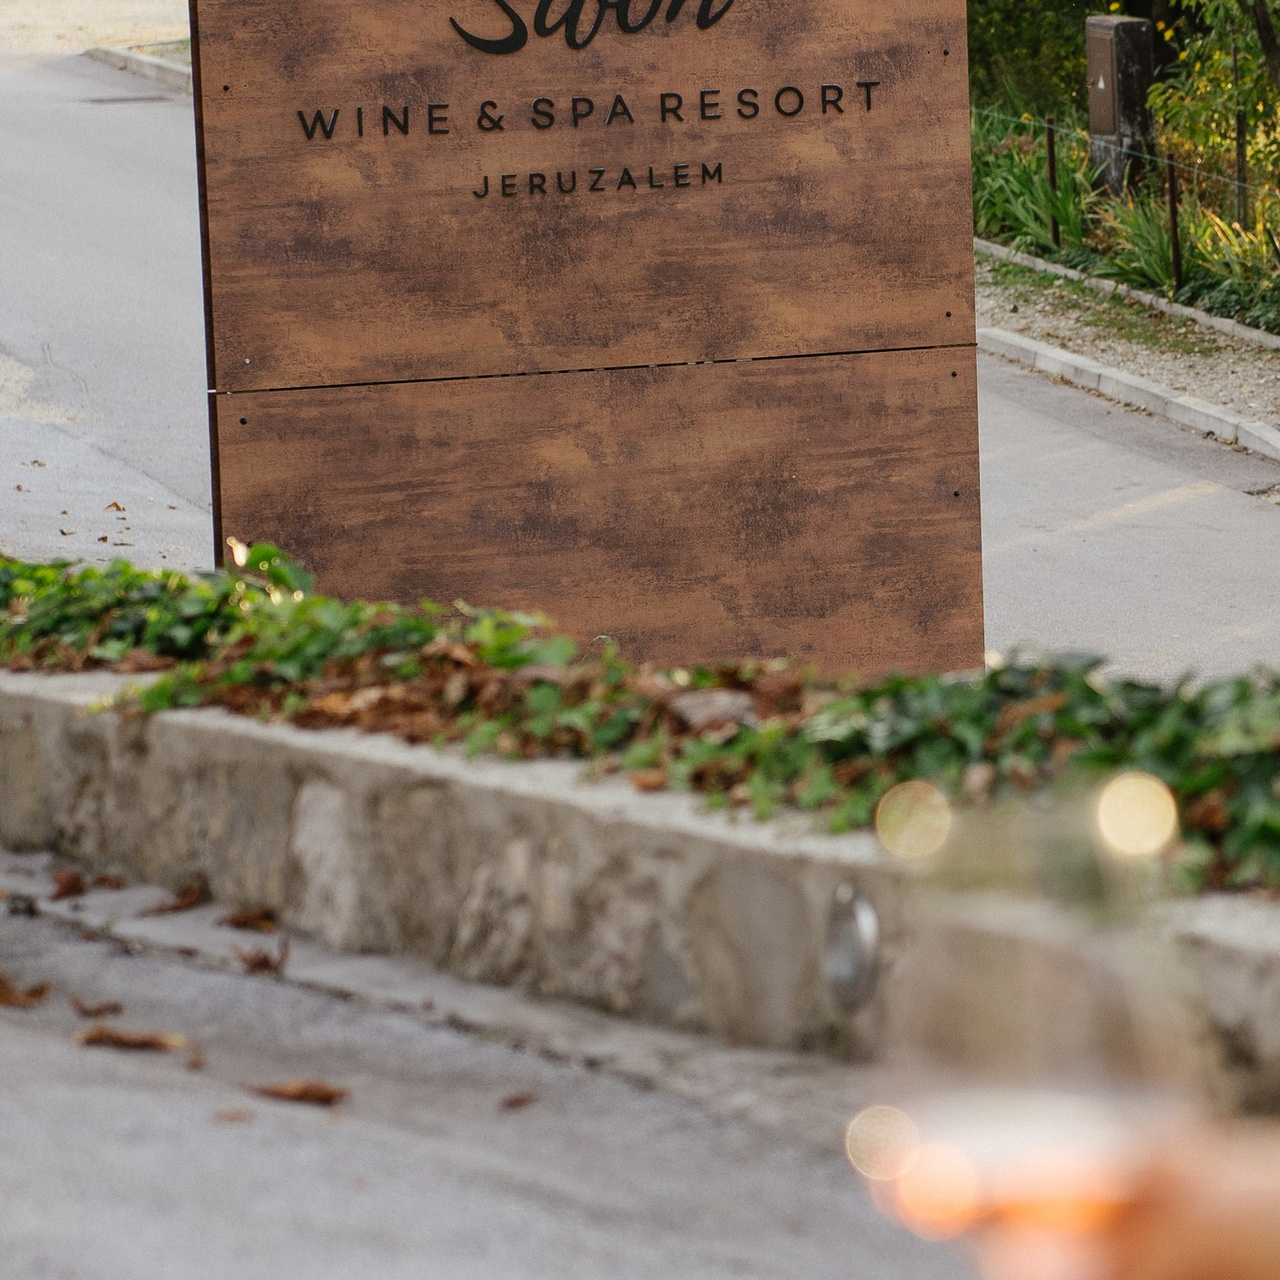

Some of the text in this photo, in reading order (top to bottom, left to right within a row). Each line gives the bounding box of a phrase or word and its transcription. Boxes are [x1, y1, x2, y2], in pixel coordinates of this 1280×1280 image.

[299, 81, 881, 141] WINE & SPA RESORT
[473, 162, 724, 199] JERUZALEM
